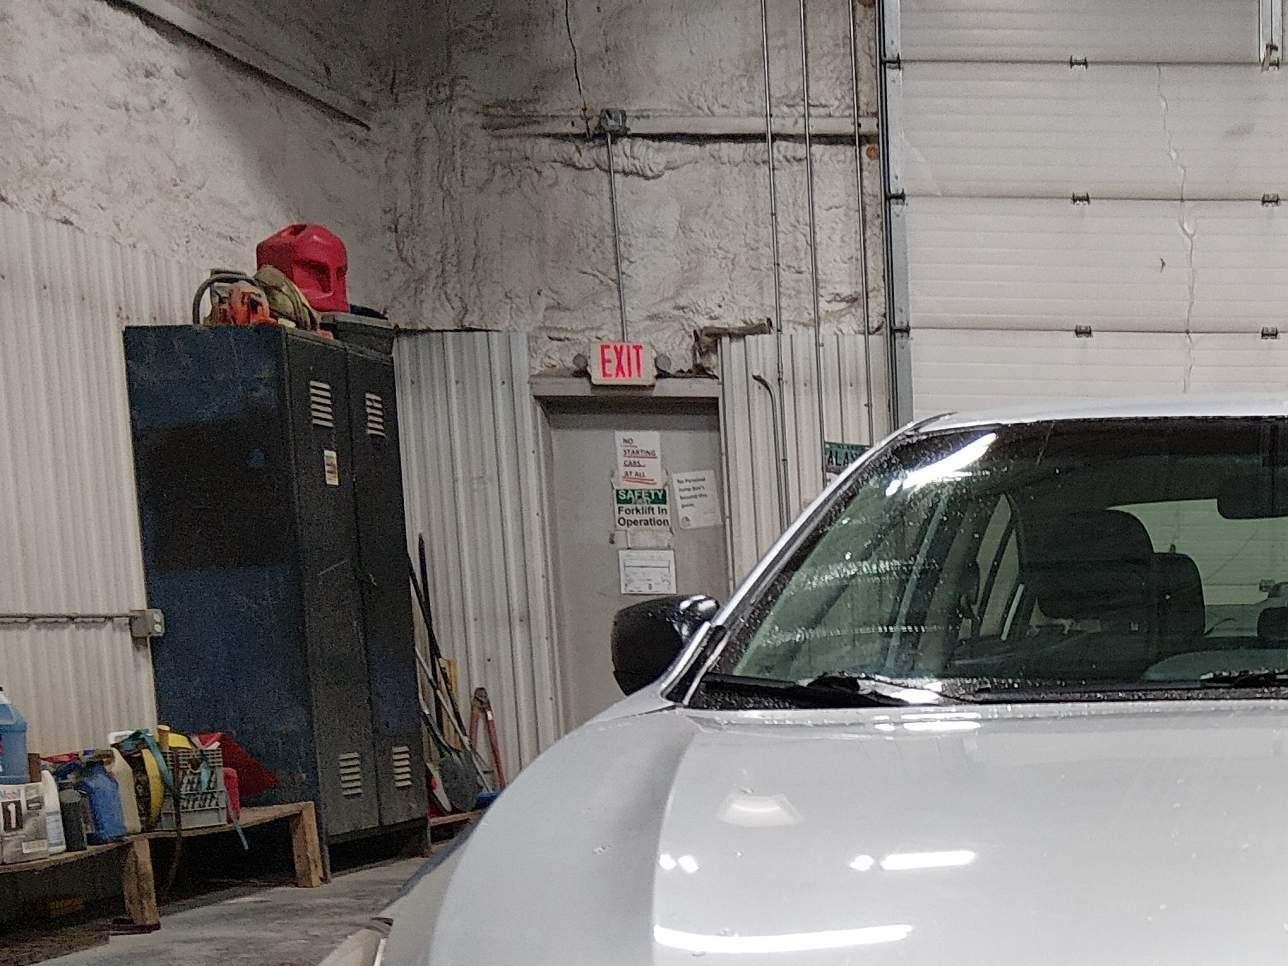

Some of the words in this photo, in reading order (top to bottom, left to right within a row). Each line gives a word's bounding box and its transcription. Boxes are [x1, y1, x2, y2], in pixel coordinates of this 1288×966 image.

[600, 344, 643, 378] EXIT
[623, 449, 657, 457] STARTING
[618, 490, 664, 500] SAFETY
[617, 506, 655, 515] Forklift
[657, 506, 668, 515] In
[617, 517, 670, 528] Operation
